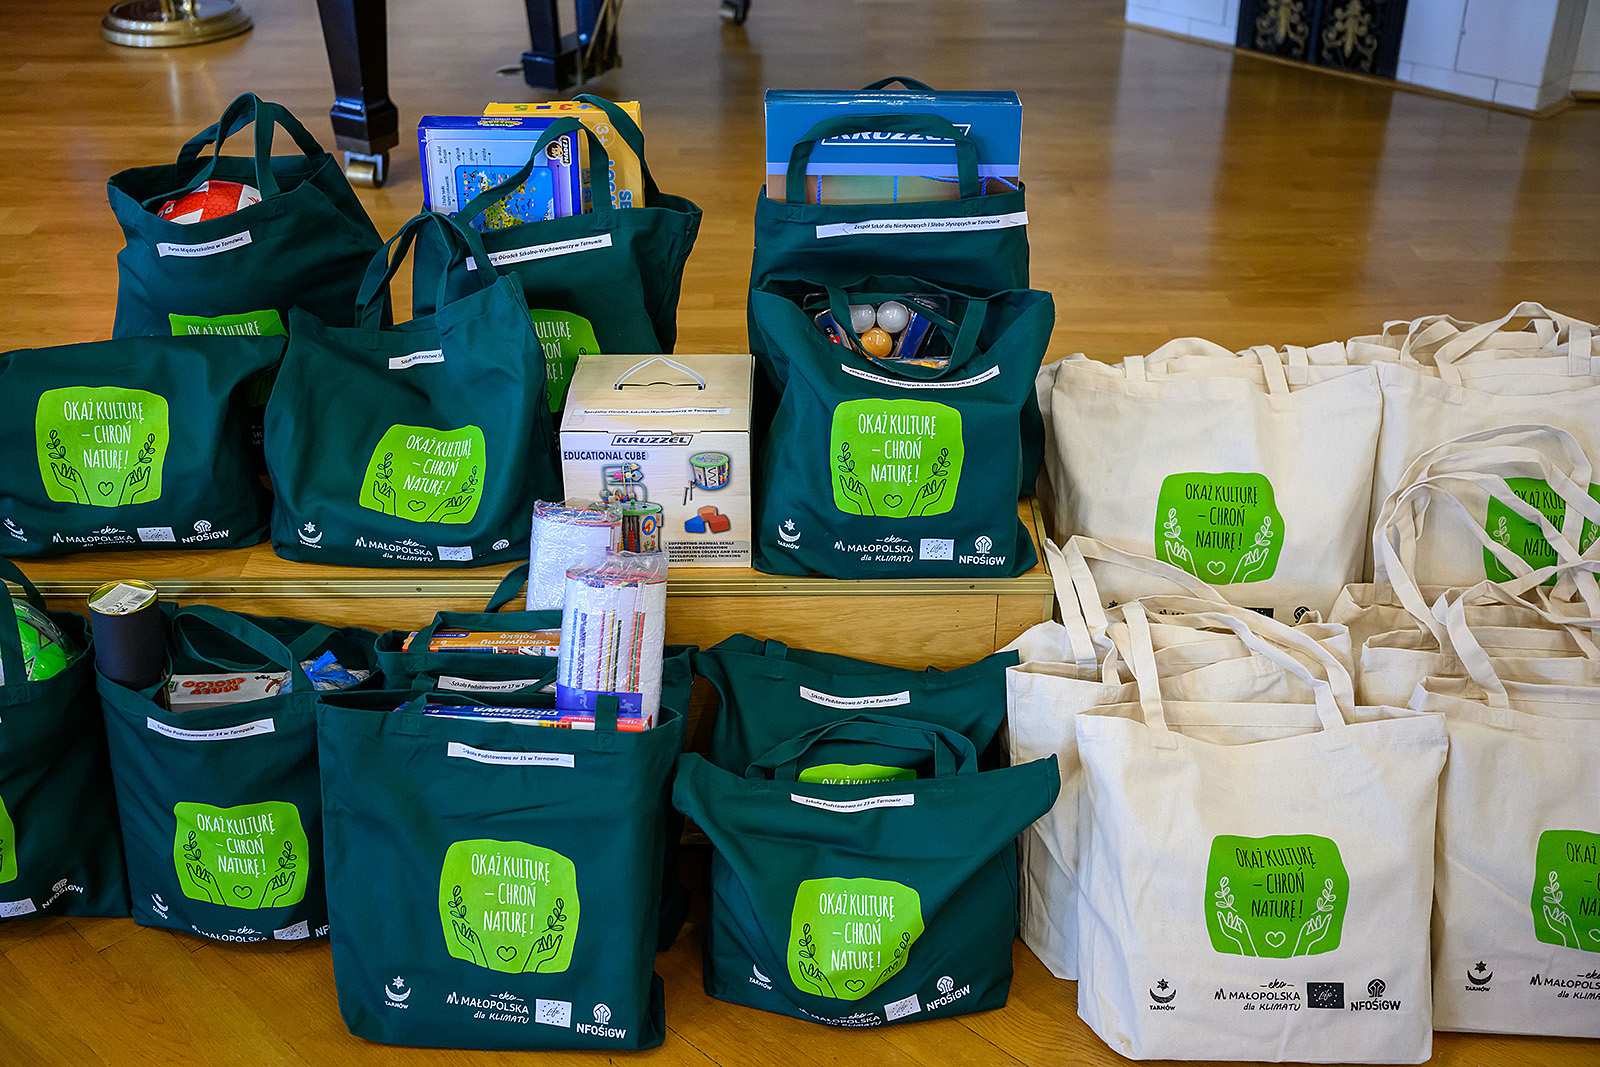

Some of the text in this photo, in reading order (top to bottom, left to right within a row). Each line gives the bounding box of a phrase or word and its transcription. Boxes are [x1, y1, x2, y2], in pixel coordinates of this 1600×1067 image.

[533, 322, 572, 340] ULTURĘ
[63, 398, 144, 424] OKAŻ KULTURĘ
[94, 420, 131, 444] CHROŃ
[858, 410, 936, 440] OKAŻ KULTURĘ
[406, 434, 472, 460] OKAŻ KULTURĘ
[564, 452, 646, 460] EDUCATIONAL CUBE
[884, 436, 922, 460] CHROŃ
[422, 457, 460, 478] CHROŃ
[1185, 482, 1258, 508] OKAŻ KULTURĘ
[1209, 504, 1246, 528] CHROŃ
[368, 540, 434, 556] MAŁOPOLSKA
[847, 544, 914, 554] MAŁOPOLSKA
[860, 554, 914, 563] dla KLIMATU
[452, 680, 468, 688] Szkoła
[472, 707, 559, 716] DROGOWA
[825, 697, 856, 706] Podstawowa
[172, 730, 207, 738] Podstawowa
[230, 726, 255, 735] Tarnowie
[197, 812, 276, 836] OKAŻ KULTURĘ
[226, 834, 265, 855] CHROŃ
[1566, 842, 1597, 865] OKAŻ
[1236, 846, 1316, 869] OKAŻ KULTURĘ
[471, 852, 550, 886] OKAŻ KULTURĘ
[1266, 867, 1305, 894] CHROŃ
[498, 882, 536, 908] CHROŃ
[818, 890, 896, 922] OKAŻ KULTURĘ
[844, 919, 882, 946] CHROŃ
[1544, 978, 1600, 990] MAŁOPOLS
[1229, 991, 1300, 1001] MAŁOPOLSKA
[1350, 997, 1400, 1012] NFOŚiGW
[1558, 990, 1600, 1000] dla KLIMA
[460, 996, 530, 1015] MAŁOPOLSKA
[1243, 1002, 1301, 1012] dla KLIMATU
[474, 1010, 530, 1024] dla KLIMATU
[576, 1022, 627, 1039] NFOŚiGW
